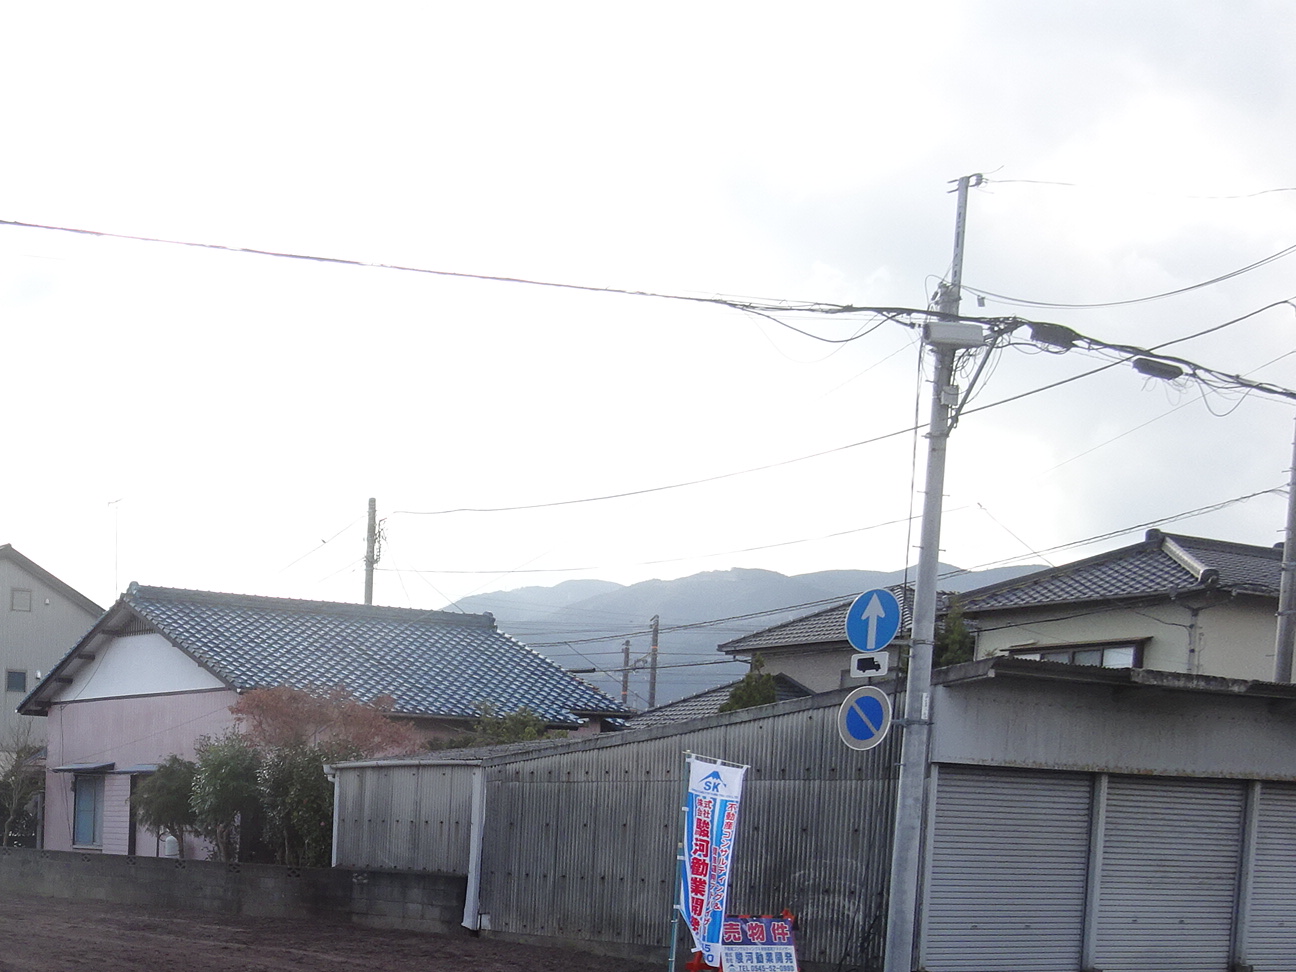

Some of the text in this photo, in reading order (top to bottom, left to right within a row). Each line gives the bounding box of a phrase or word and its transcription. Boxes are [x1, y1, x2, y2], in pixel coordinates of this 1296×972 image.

[704, 781, 721, 792] SK
[724, 922, 790, 942] 売物件
